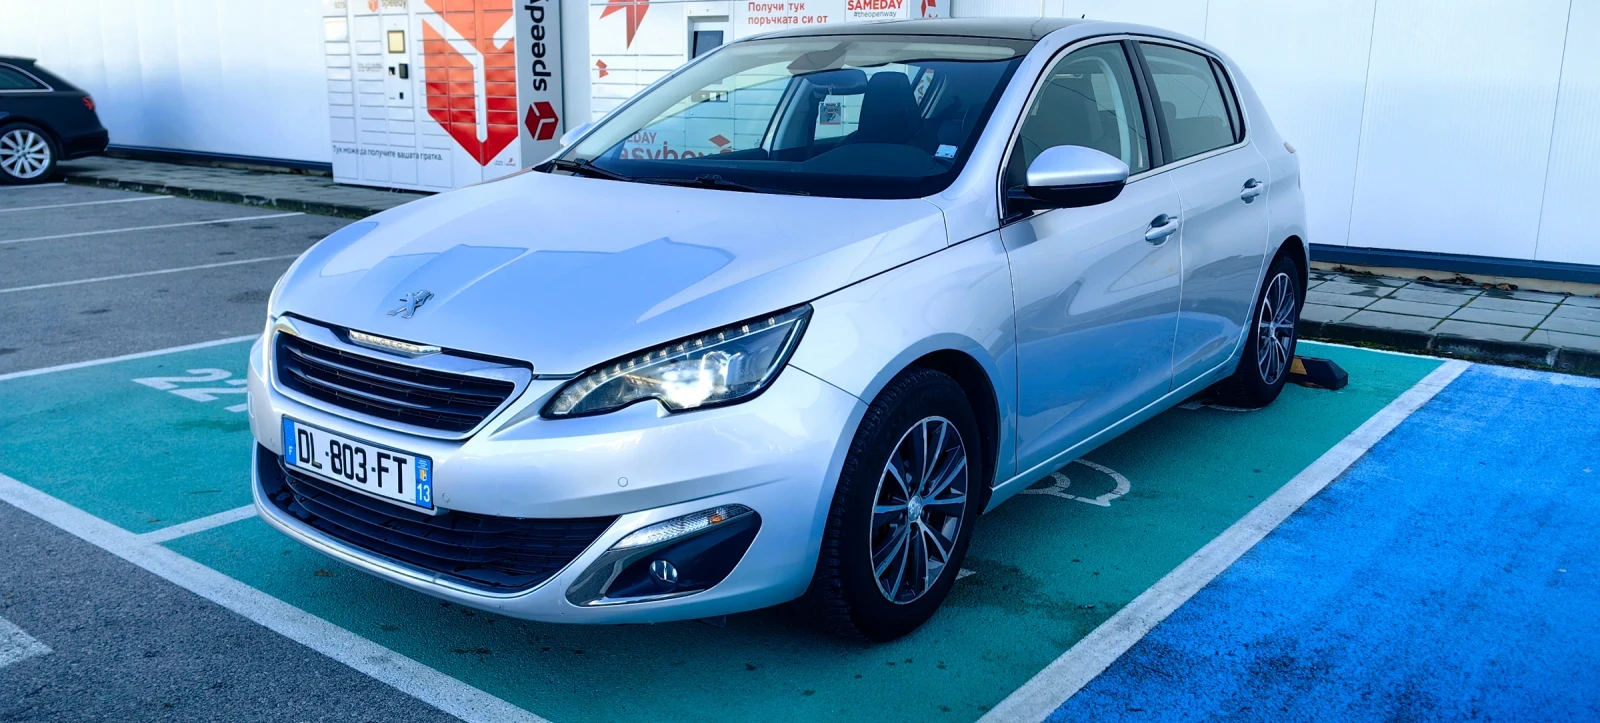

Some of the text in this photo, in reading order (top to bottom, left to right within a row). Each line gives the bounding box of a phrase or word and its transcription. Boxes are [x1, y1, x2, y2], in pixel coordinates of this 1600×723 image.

[748, 2, 805, 13] Получи тук
[847, 0, 903, 10] SAMEDAY
[853, 10, 897, 18] #theopenway
[748, 15, 829, 26] поръчката си от
[333, 144, 342, 155] Тук
[367, 148, 396, 158] получите
[397, 151, 419, 159] вашата
[288, 445, 293, 456] F
[416, 483, 431, 503] 13
